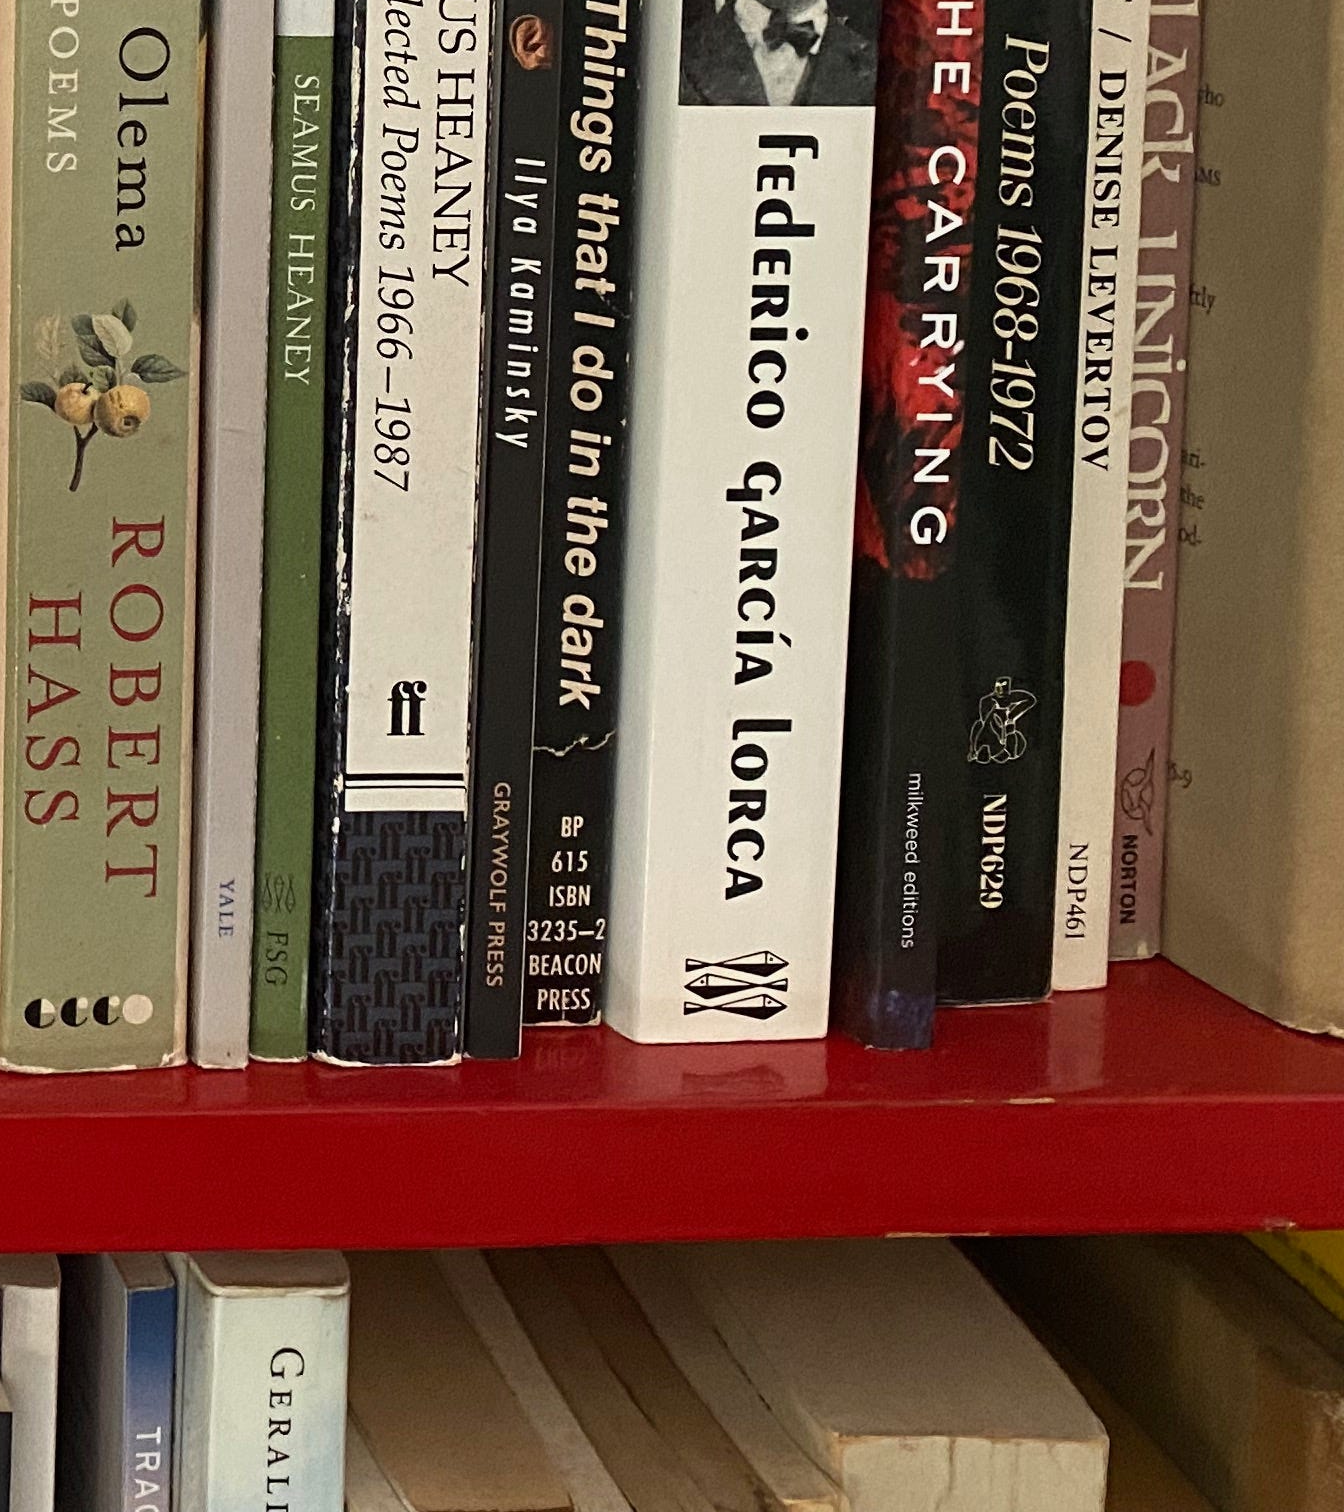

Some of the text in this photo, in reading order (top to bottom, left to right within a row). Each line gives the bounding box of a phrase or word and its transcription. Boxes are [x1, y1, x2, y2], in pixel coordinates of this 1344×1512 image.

[114, 25, 172, 251] Olema
[432, 67, 475, 287] HEANEY
[995, 35, 1050, 213] Poems
[1089, 68, 1132, 229] DENISE
[282, 72, 320, 385] SEAMUS HEANEY
[496, 156, 547, 450] Ilya Kaminsky
[575, 190, 621, 295] that
[911, 144, 966, 547] CARRYING
[1080, 248, 1121, 471] LEVERTOV
[564, 490, 609, 576] the
[24, 592, 83, 826] HASS
[104, 514, 165, 898] ROBERT
[558, 592, 604, 709] dark
[548, 883, 591, 907] ISBN
[550, 851, 587, 873] 615
[561, 816, 585, 838] BP
[901, 771, 925, 950] milkweed editions
[980, 793, 1007, 908] NDP629
[528, 954, 603, 976] BEACON
[537, 988, 591, 1011] PRESS
